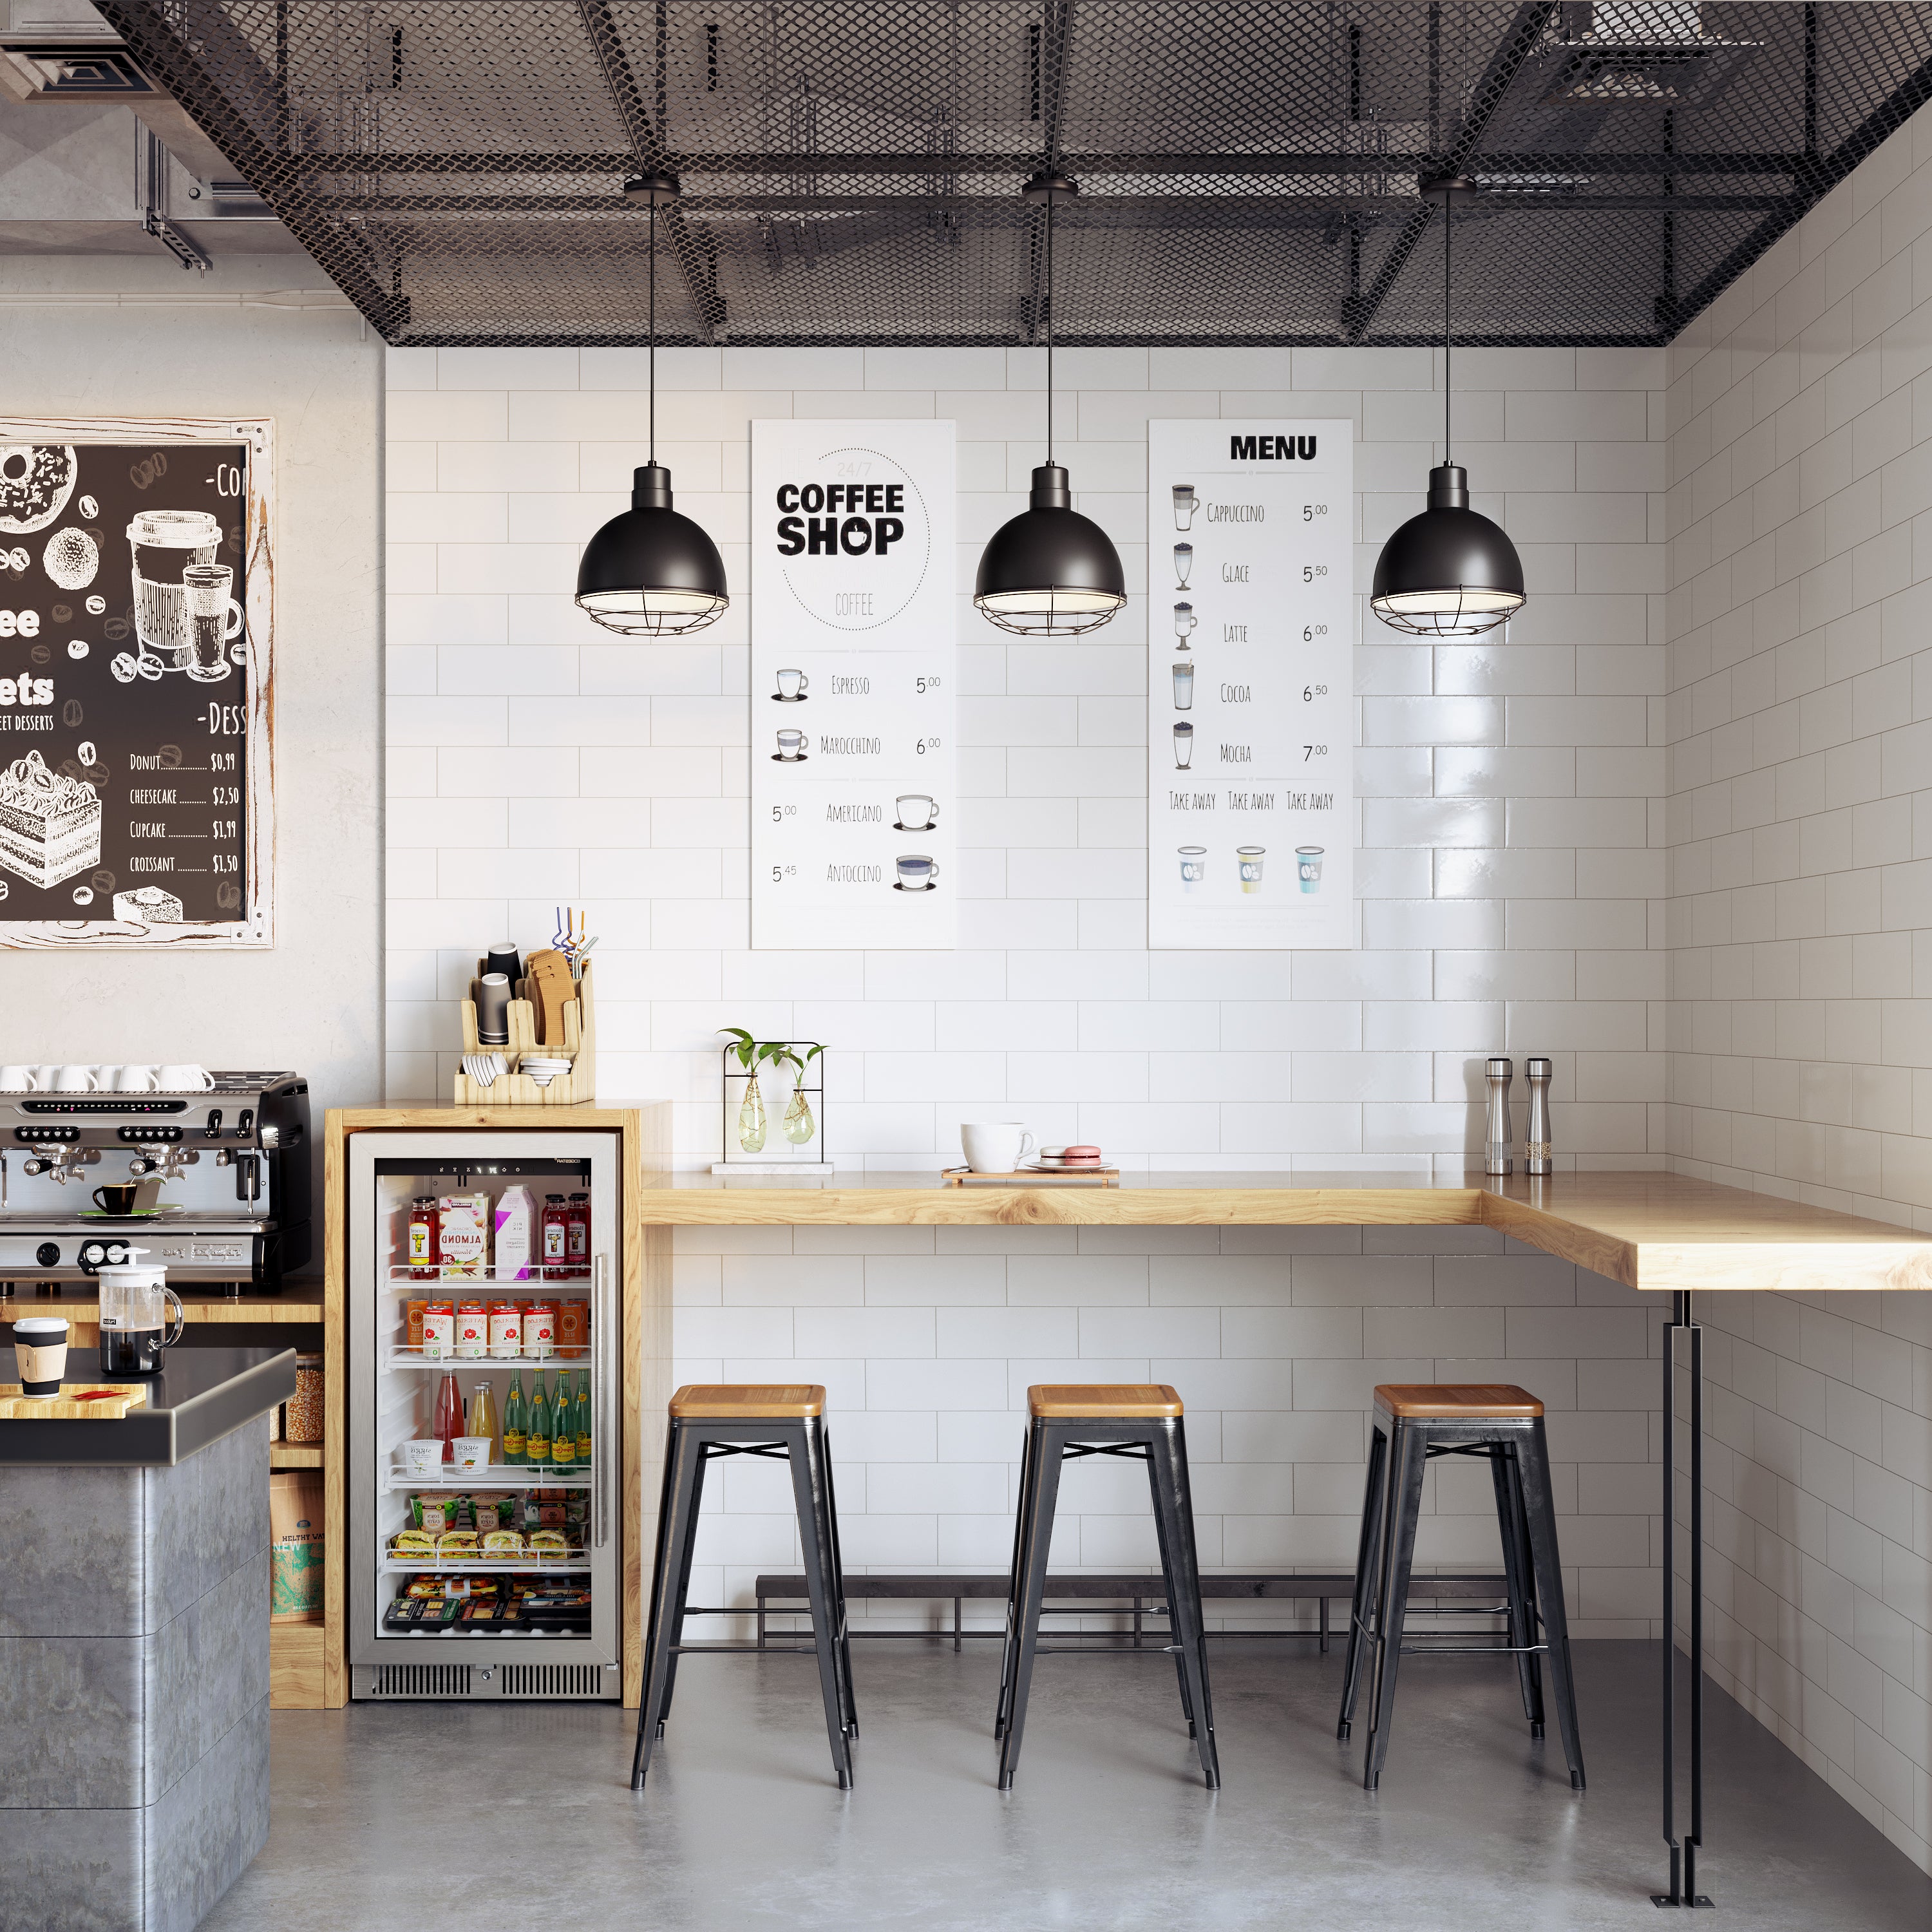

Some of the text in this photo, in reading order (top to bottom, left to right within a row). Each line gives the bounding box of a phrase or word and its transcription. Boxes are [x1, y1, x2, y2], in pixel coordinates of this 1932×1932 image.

[1231, 436, 1316, 460] MENU
[838, 462, 872, 477] 24/7
[777, 484, 904, 513] COFFEE
[1207, 503, 1264, 522] CAPPUCCINO
[777, 516, 904, 556] SHOP
[1222, 563, 1249, 583] GLACE
[836, 593, 874, 616] COFFEE
[1224, 623, 1247, 643] LATTE
[832, 675, 869, 695] ESPRESSO
[1220, 683, 1251, 703] COCOA
[15, 715, 53, 730] DESSERTS
[820, 735, 880, 755] MAROCCHINO
[1220, 743, 1251, 762] MOCHA
[211, 753, 235, 772] $0,99
[130, 787, 239, 806] CHEESECAKE $2,50
[1169, 791, 1216, 811] TAKE AWAY
[1227, 791, 1274, 811] TAKE AWAY
[1286, 791, 1334, 811] TAKE AWAY
[826, 803, 882, 823] AMERICANO
[130, 820, 236, 840] CUPCAKE $1,99
[130, 854, 238, 874] CROISSANT $1,50
[826, 864, 881, 882] ANTOCCINO
[273, 1540, 301, 1552] NEW
